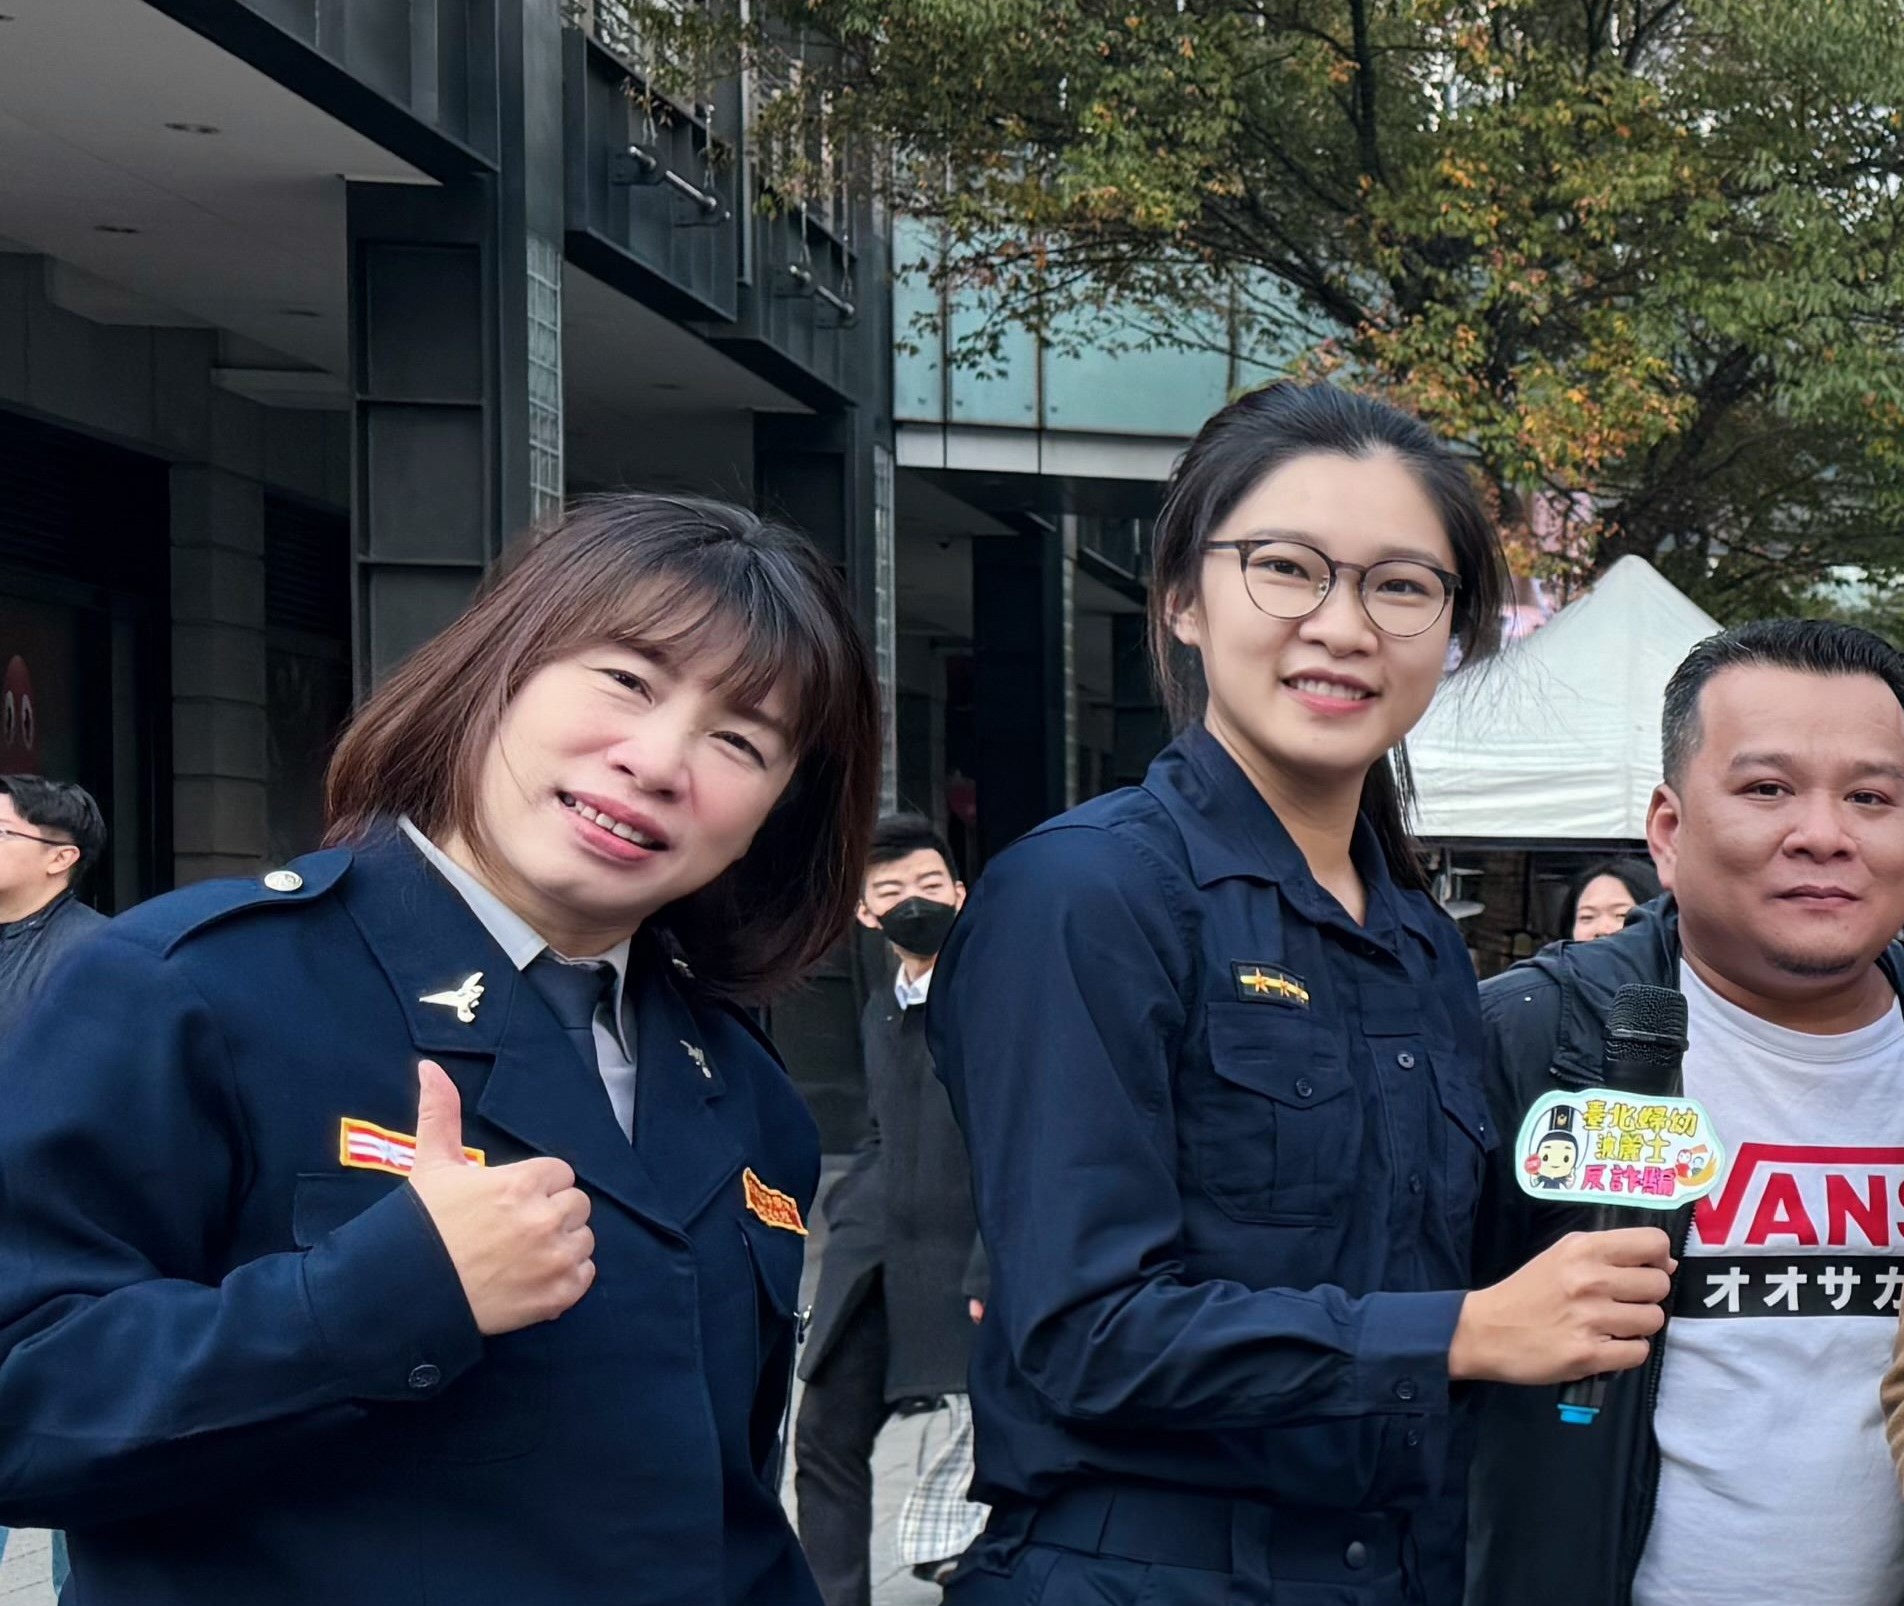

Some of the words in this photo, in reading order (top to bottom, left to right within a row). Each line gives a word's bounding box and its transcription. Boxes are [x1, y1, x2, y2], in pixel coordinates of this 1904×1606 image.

[1582, 1099, 1699, 1138] 臺北婦幼
[1594, 1133, 1672, 1164] 波麗士
[1580, 1164, 1677, 1197] 反詐騙
